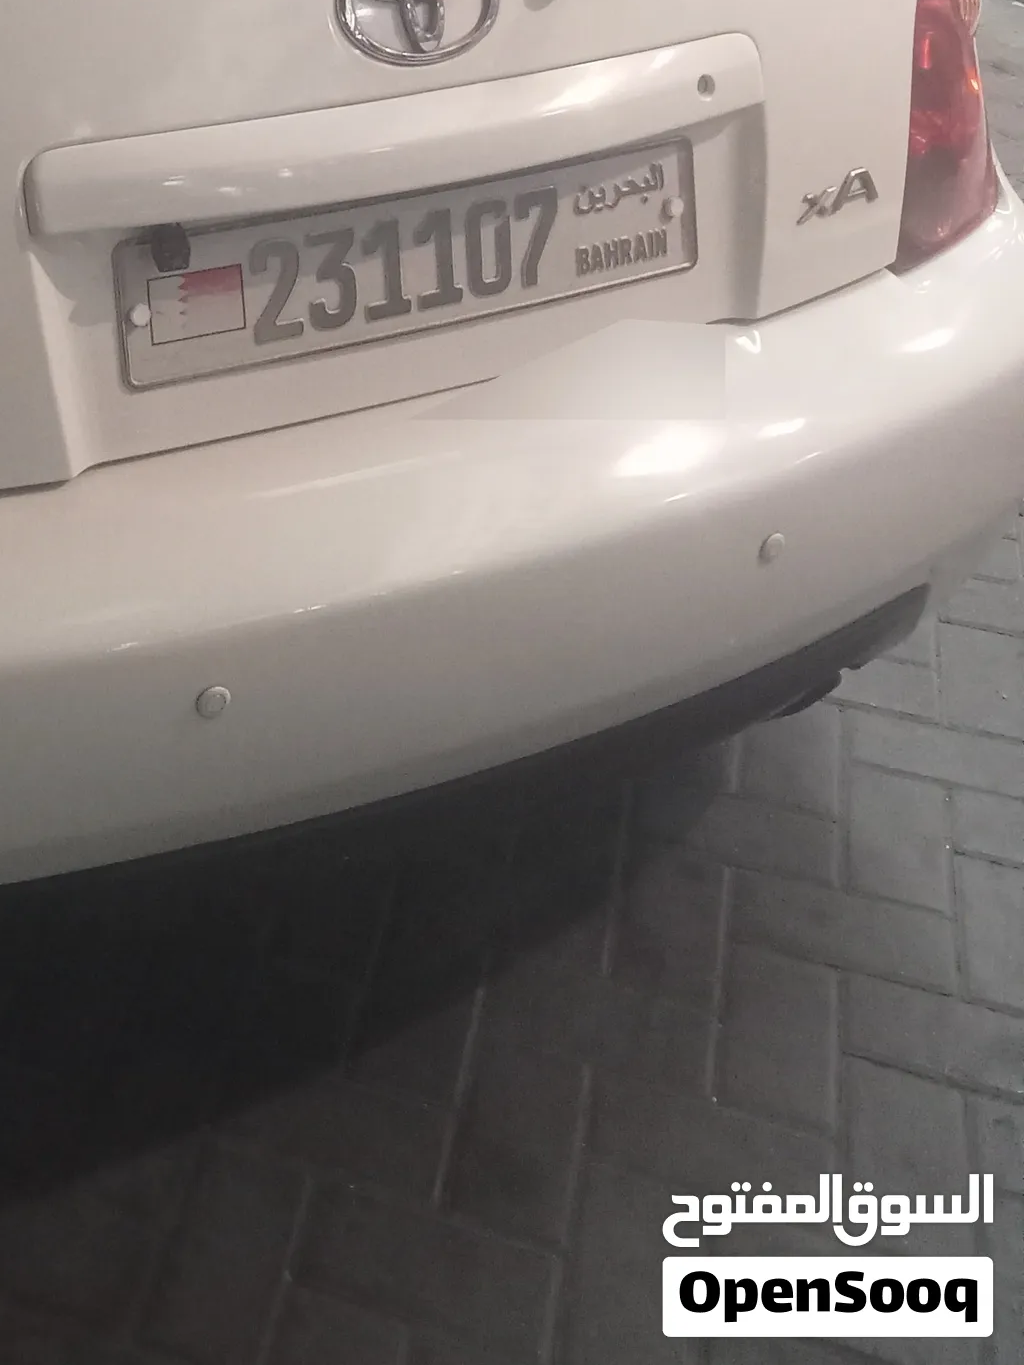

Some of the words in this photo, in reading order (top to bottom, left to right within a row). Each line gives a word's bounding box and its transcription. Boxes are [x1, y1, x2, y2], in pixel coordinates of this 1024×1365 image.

[572, 161, 666, 217] البحرين
[248, 186, 558, 345] 231107
[575, 227, 669, 277] BAHRAIN
